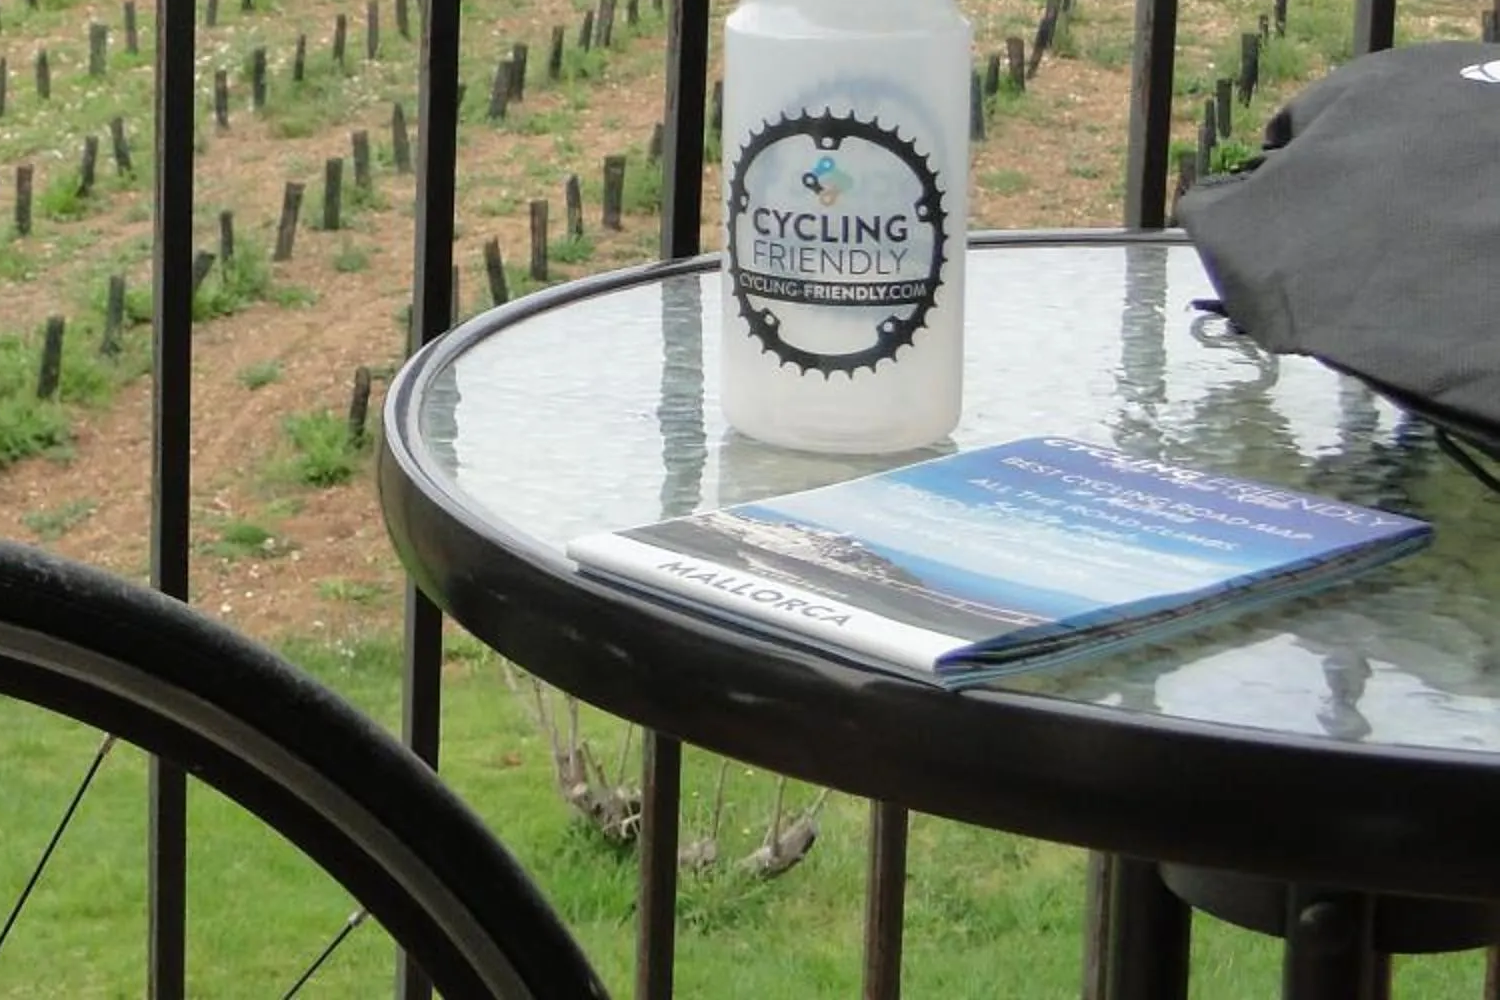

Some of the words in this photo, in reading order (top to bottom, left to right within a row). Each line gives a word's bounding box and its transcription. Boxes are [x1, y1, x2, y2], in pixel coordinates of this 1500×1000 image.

[752, 207, 909, 245] CYCLING
[752, 239, 910, 275] FRIENDLY
[1043, 438, 1206, 482] CYCLING
[1205, 477, 1402, 528] FRIENDLY
[657, 560, 851, 628] MALLORCA
